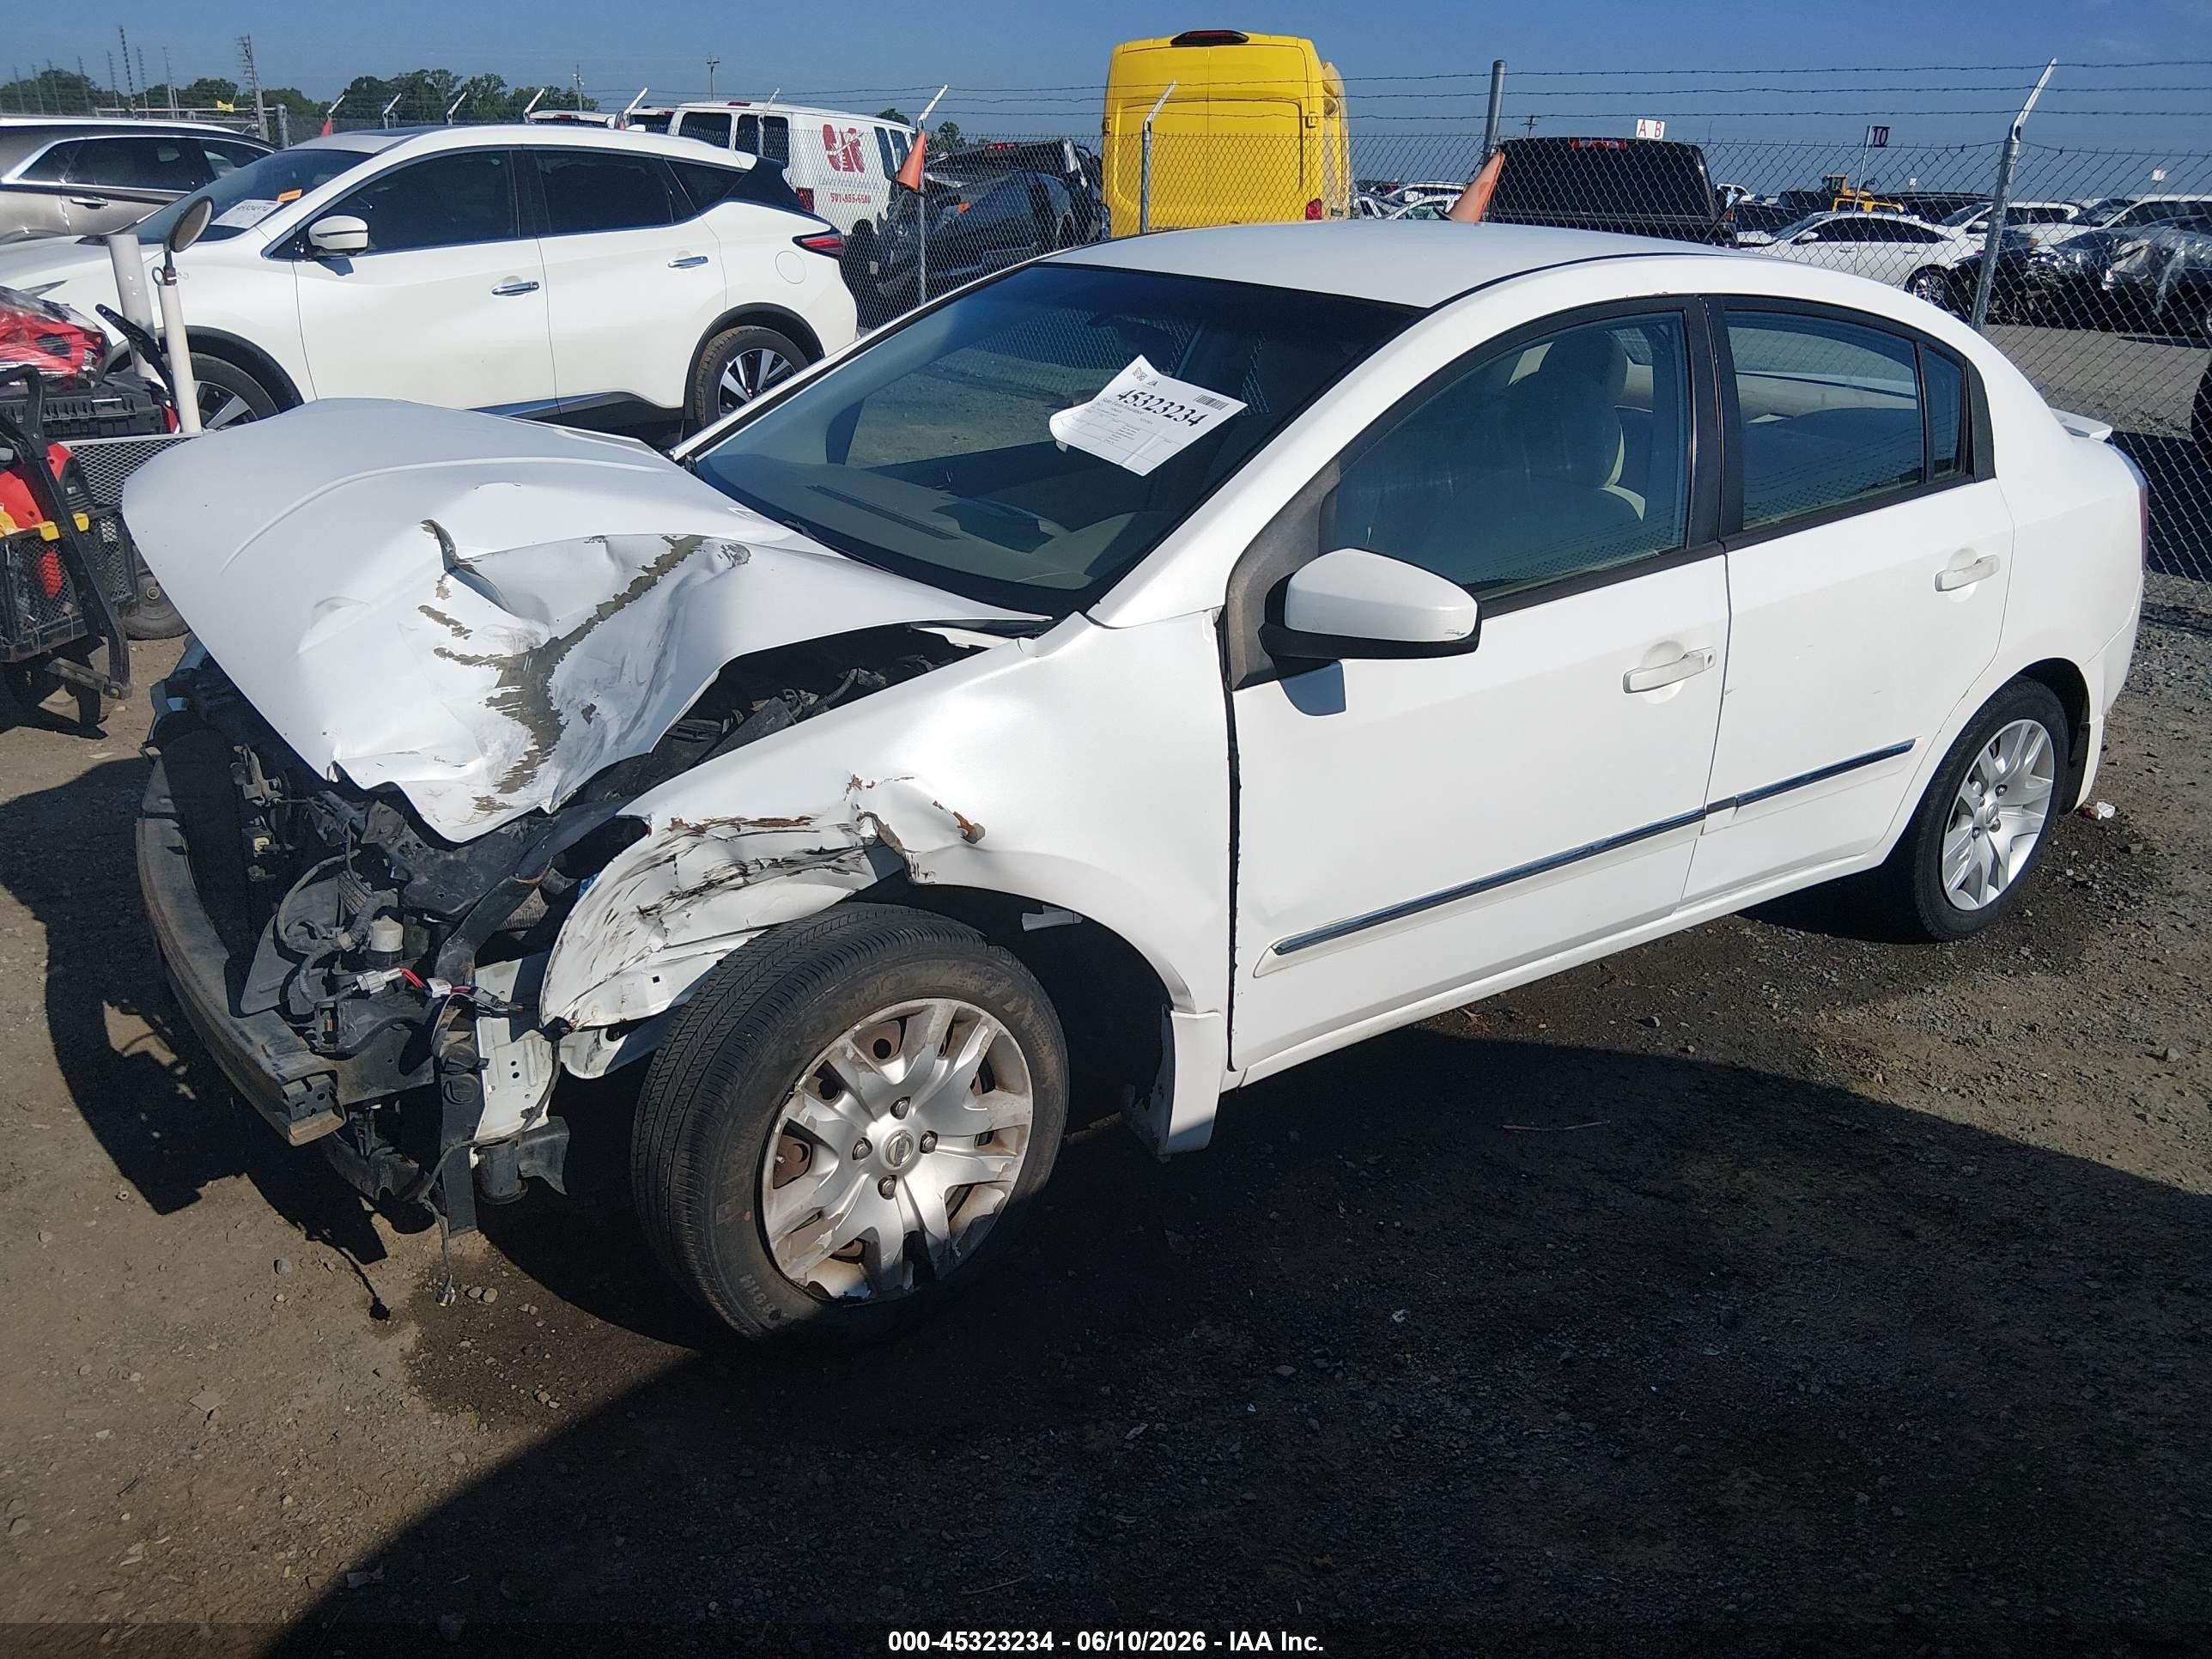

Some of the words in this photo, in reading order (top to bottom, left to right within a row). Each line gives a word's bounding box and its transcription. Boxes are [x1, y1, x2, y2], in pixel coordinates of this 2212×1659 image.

[1638, 119, 1647, 137] A
[1655, 121, 1662, 138] B
[1873, 128, 1888, 146] 10
[1117, 389, 1209, 427] 45323234
